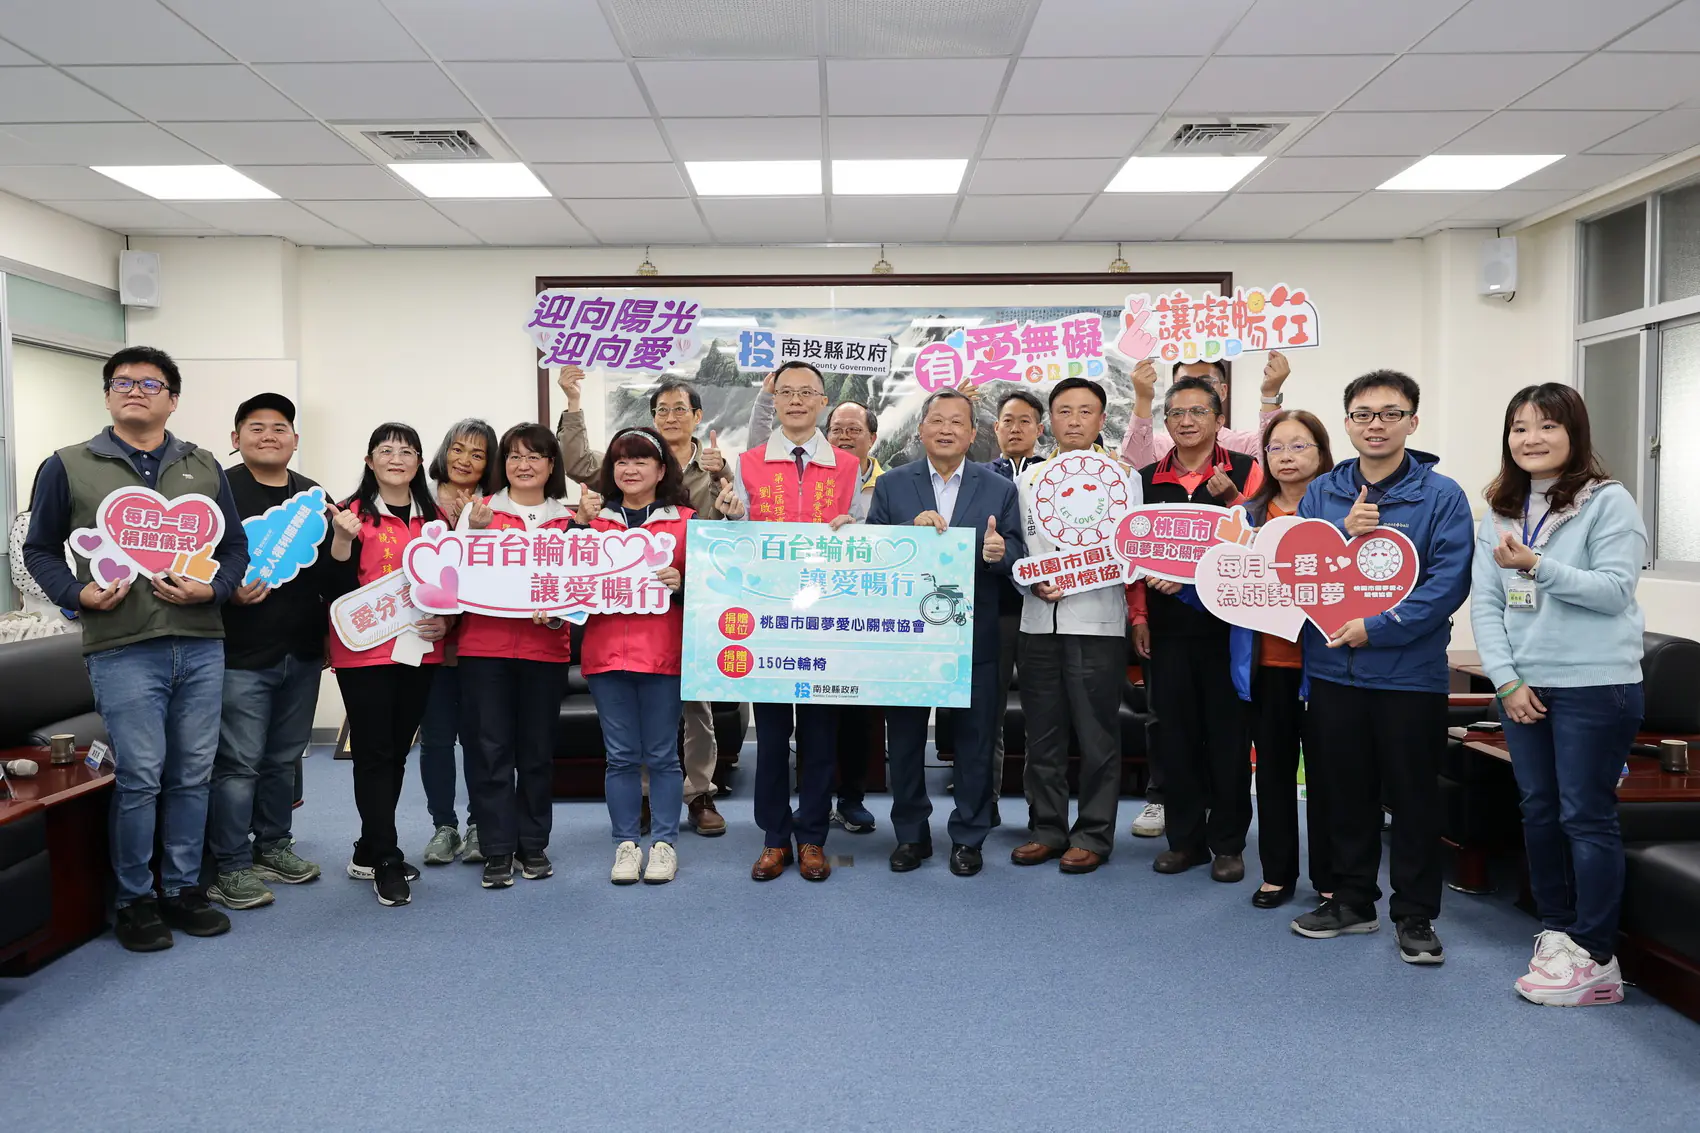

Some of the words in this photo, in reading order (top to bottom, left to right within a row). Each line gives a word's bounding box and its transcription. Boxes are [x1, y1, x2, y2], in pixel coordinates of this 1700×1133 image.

[528, 295, 698, 335] 迎向陽光
[544, 332, 673, 370] 迎向愛
[781, 338, 888, 363] 南投縣政府
[920, 318, 1102, 388] 有愛無礙
[811, 361, 837, 371] County
[839, 362, 886, 373] Government
[124, 506, 199, 532] 每月一愛
[1059, 506, 1072, 519] LET
[1074, 515, 1095, 525] LOVE
[1095, 497, 1105, 515] LIVE
[121, 529, 196, 552] 捐贈儀式
[1154, 517, 1210, 540] 桃園市
[465, 533, 601, 567] 百台輪椅
[760, 533, 873, 563] 百台輪椅
[1126, 540, 1210, 560] 圓夢愛心關懷
[1055, 564, 1123, 591] 關懷協
[1217, 553, 1318, 578] 每月一愛
[530, 572, 668, 609] 讓愛暢行
[800, 567, 916, 597] 讓愛暢行
[1217, 582, 1345, 607] 為弱勢圓夢
[724, 612, 749, 624] 捐贈
[724, 623, 748, 635] 單位
[760, 614, 926, 634] 桃園市圓夢愛心關懷協會
[723, 661, 747, 673] 項目
[758, 655, 827, 671] 150台輪椅
[812, 684, 859, 695] 南投縣政府
